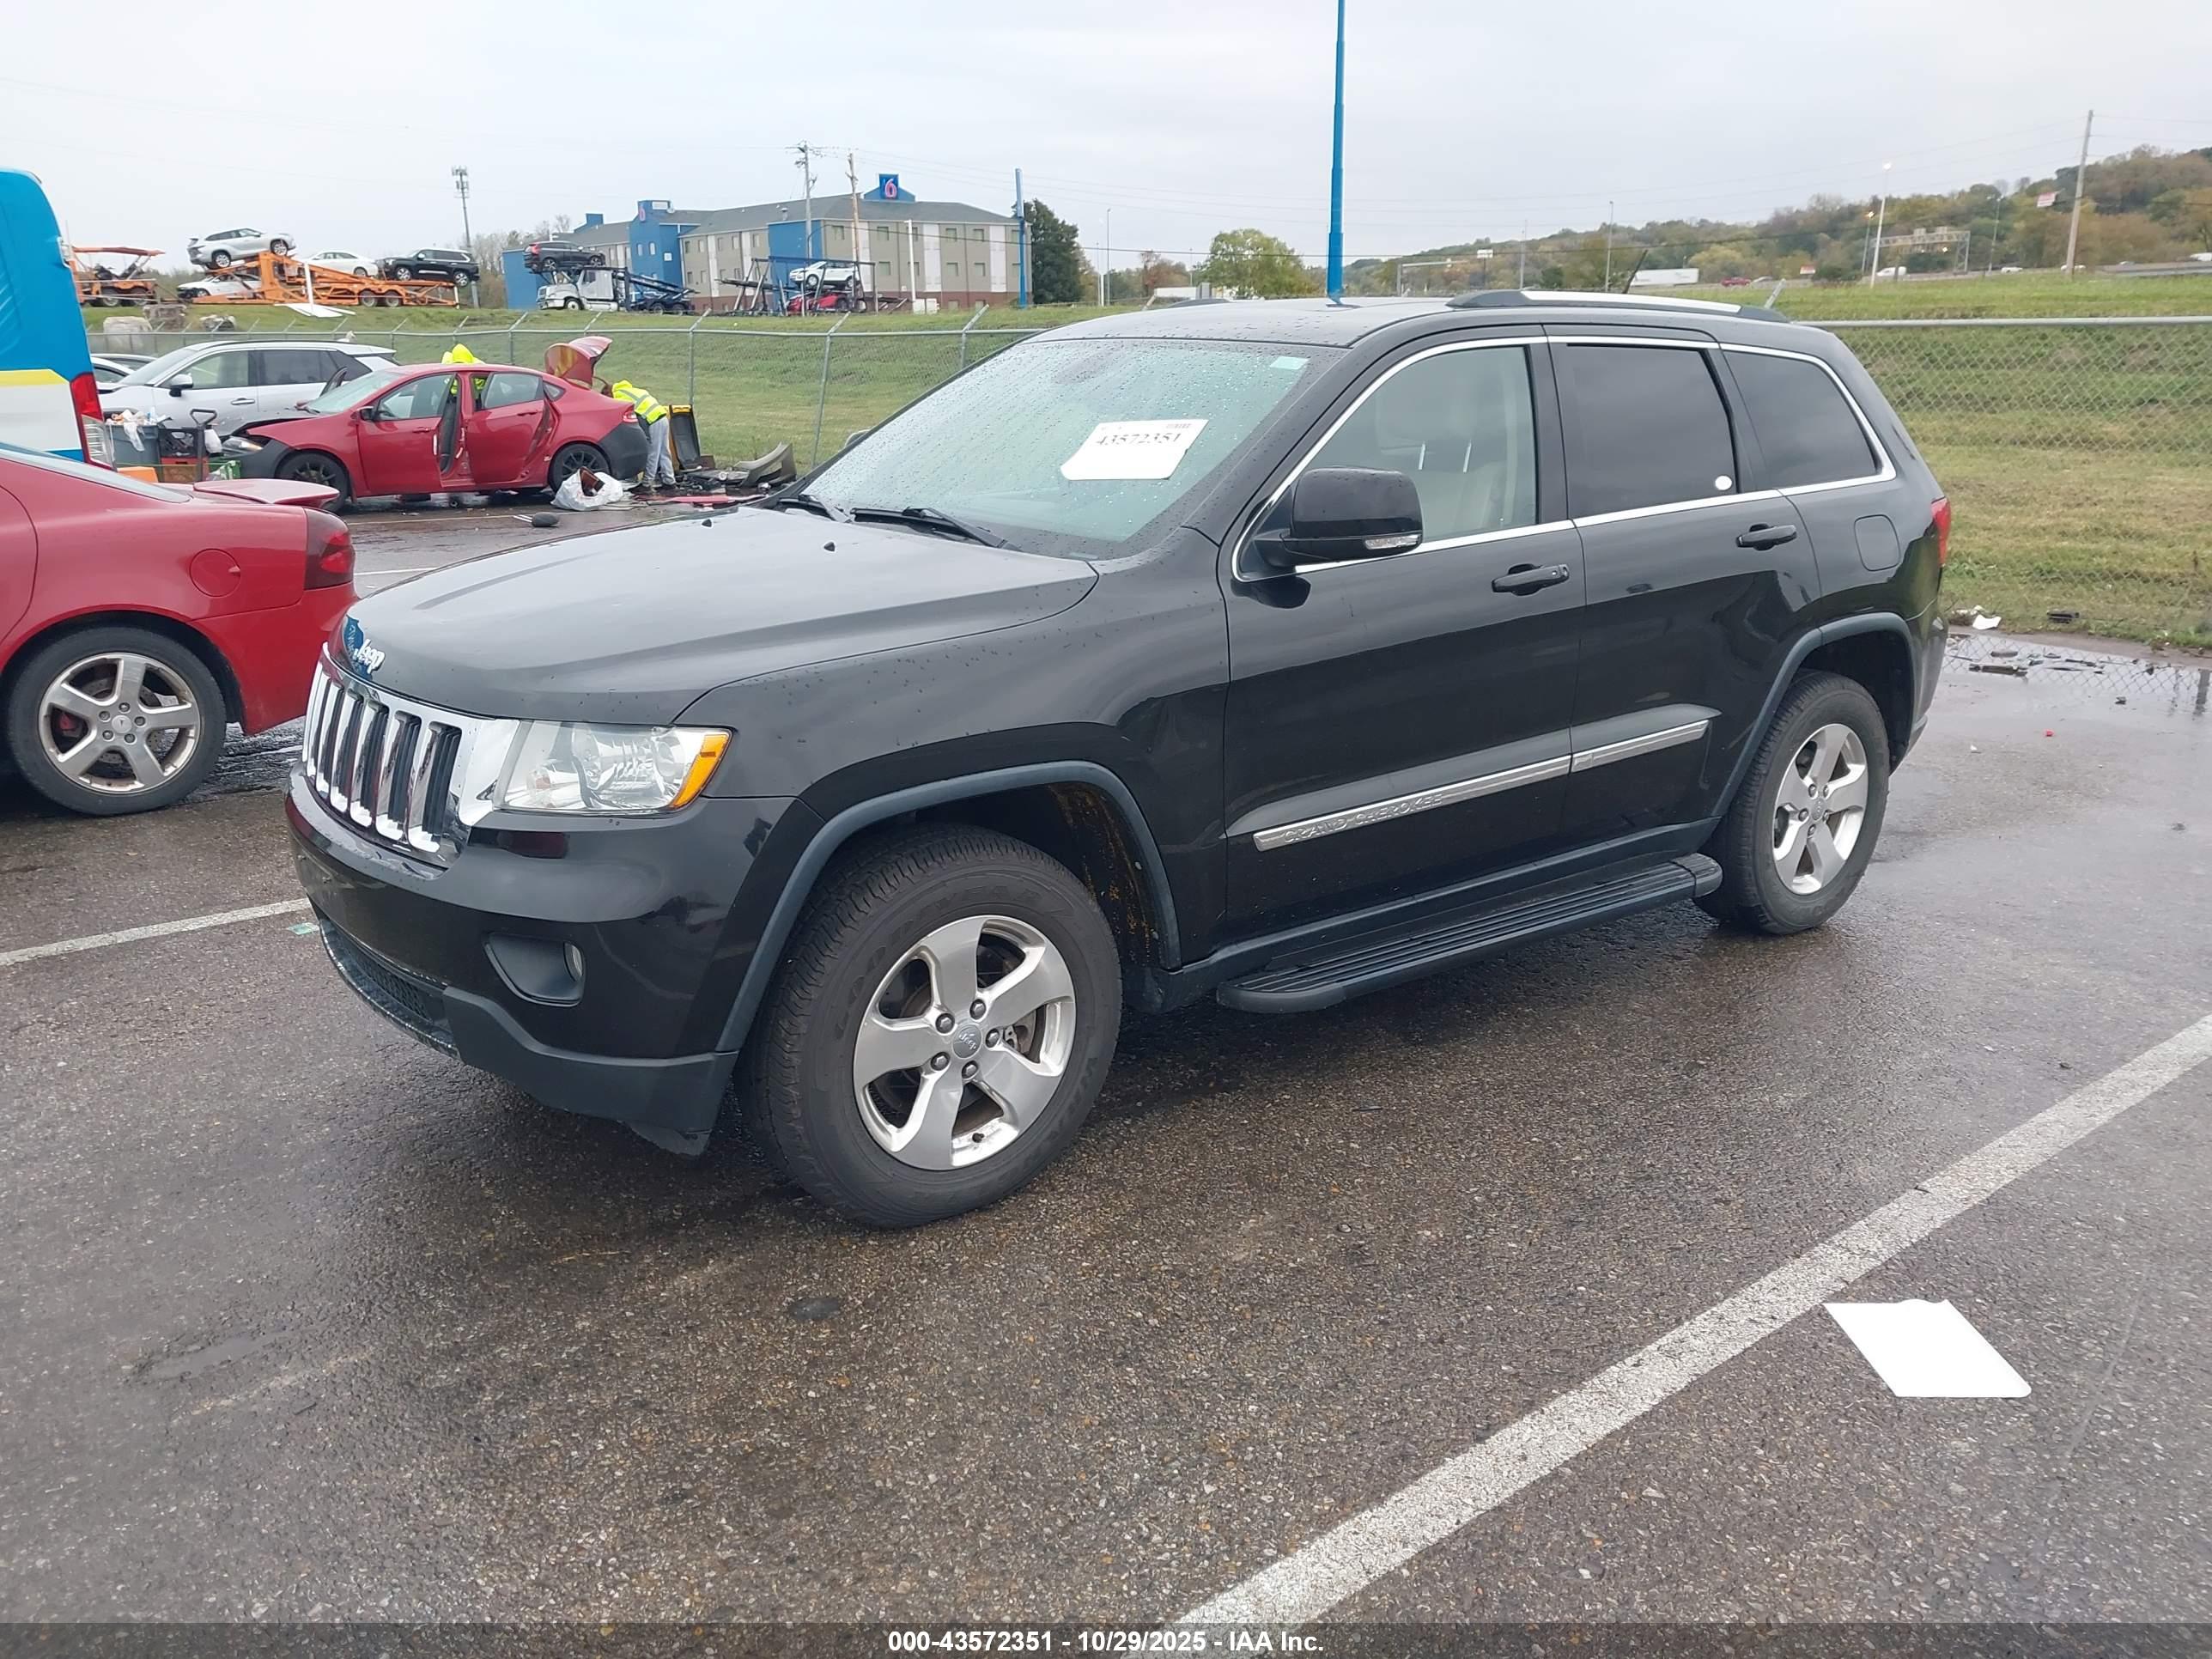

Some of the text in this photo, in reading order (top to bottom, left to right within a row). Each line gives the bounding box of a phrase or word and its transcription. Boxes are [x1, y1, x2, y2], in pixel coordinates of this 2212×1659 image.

[884, 178, 897, 199] 6
[1096, 432, 1182, 446] 43572351
[353, 639, 386, 674] Jeep
[1284, 793, 1443, 843] GRAND CHEROKEE
